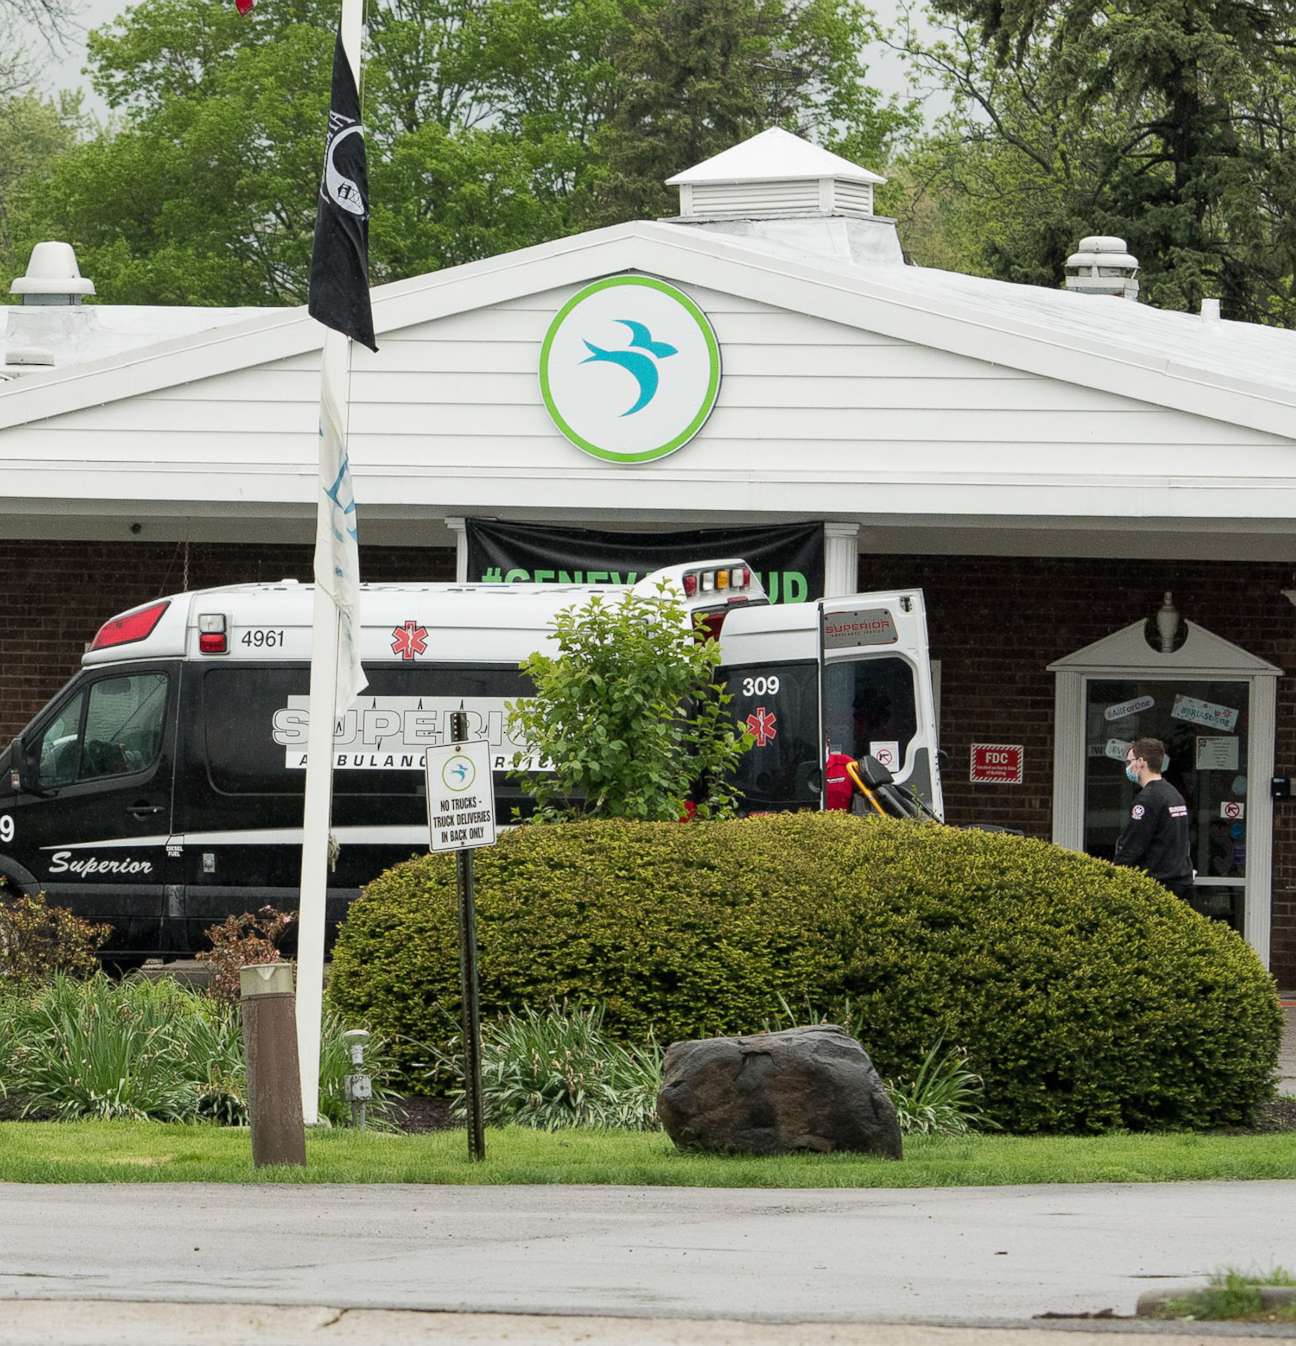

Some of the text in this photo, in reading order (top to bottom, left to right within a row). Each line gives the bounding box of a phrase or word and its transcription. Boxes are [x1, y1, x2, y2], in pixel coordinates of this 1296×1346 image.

[241, 630, 284, 647] 4961
[742, 675, 780, 697] 309
[985, 752, 1009, 764] FDC
[440, 800, 450, 812] NO
[452, 797, 477, 811] TRUCKS
[433, 810, 491, 829] TRUCK DELIVERIES
[441, 827, 484, 843] IN BACK ONLY
[49, 851, 153, 878] Superior
